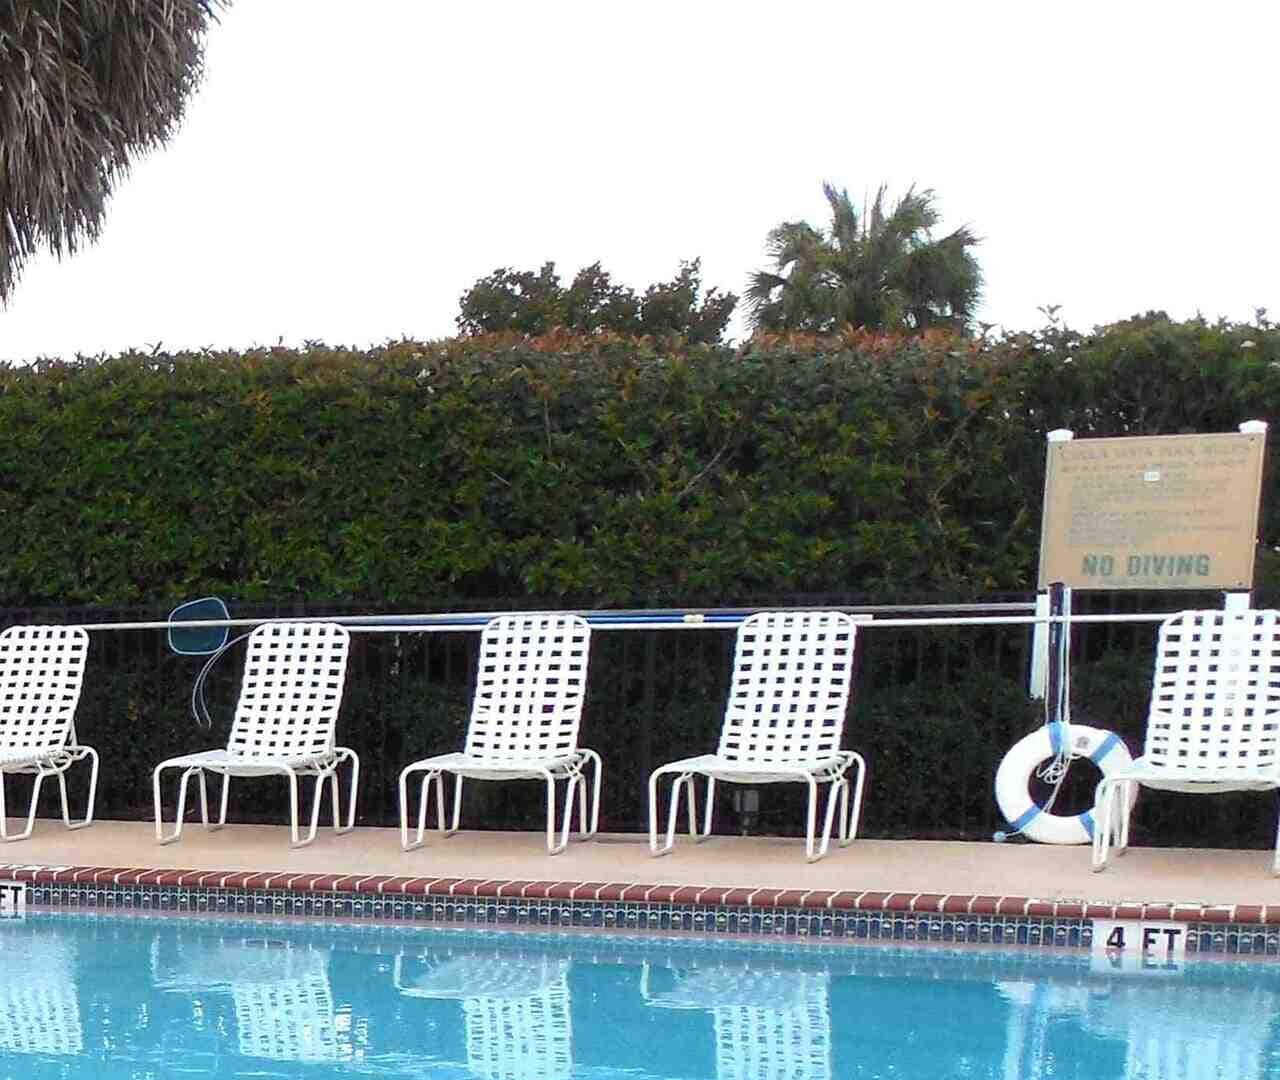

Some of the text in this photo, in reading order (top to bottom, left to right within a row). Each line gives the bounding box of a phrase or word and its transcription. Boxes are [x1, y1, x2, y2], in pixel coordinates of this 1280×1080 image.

[1081, 553, 1210, 577] NO DIVING
[1106, 927, 1181, 951] 4 FT
